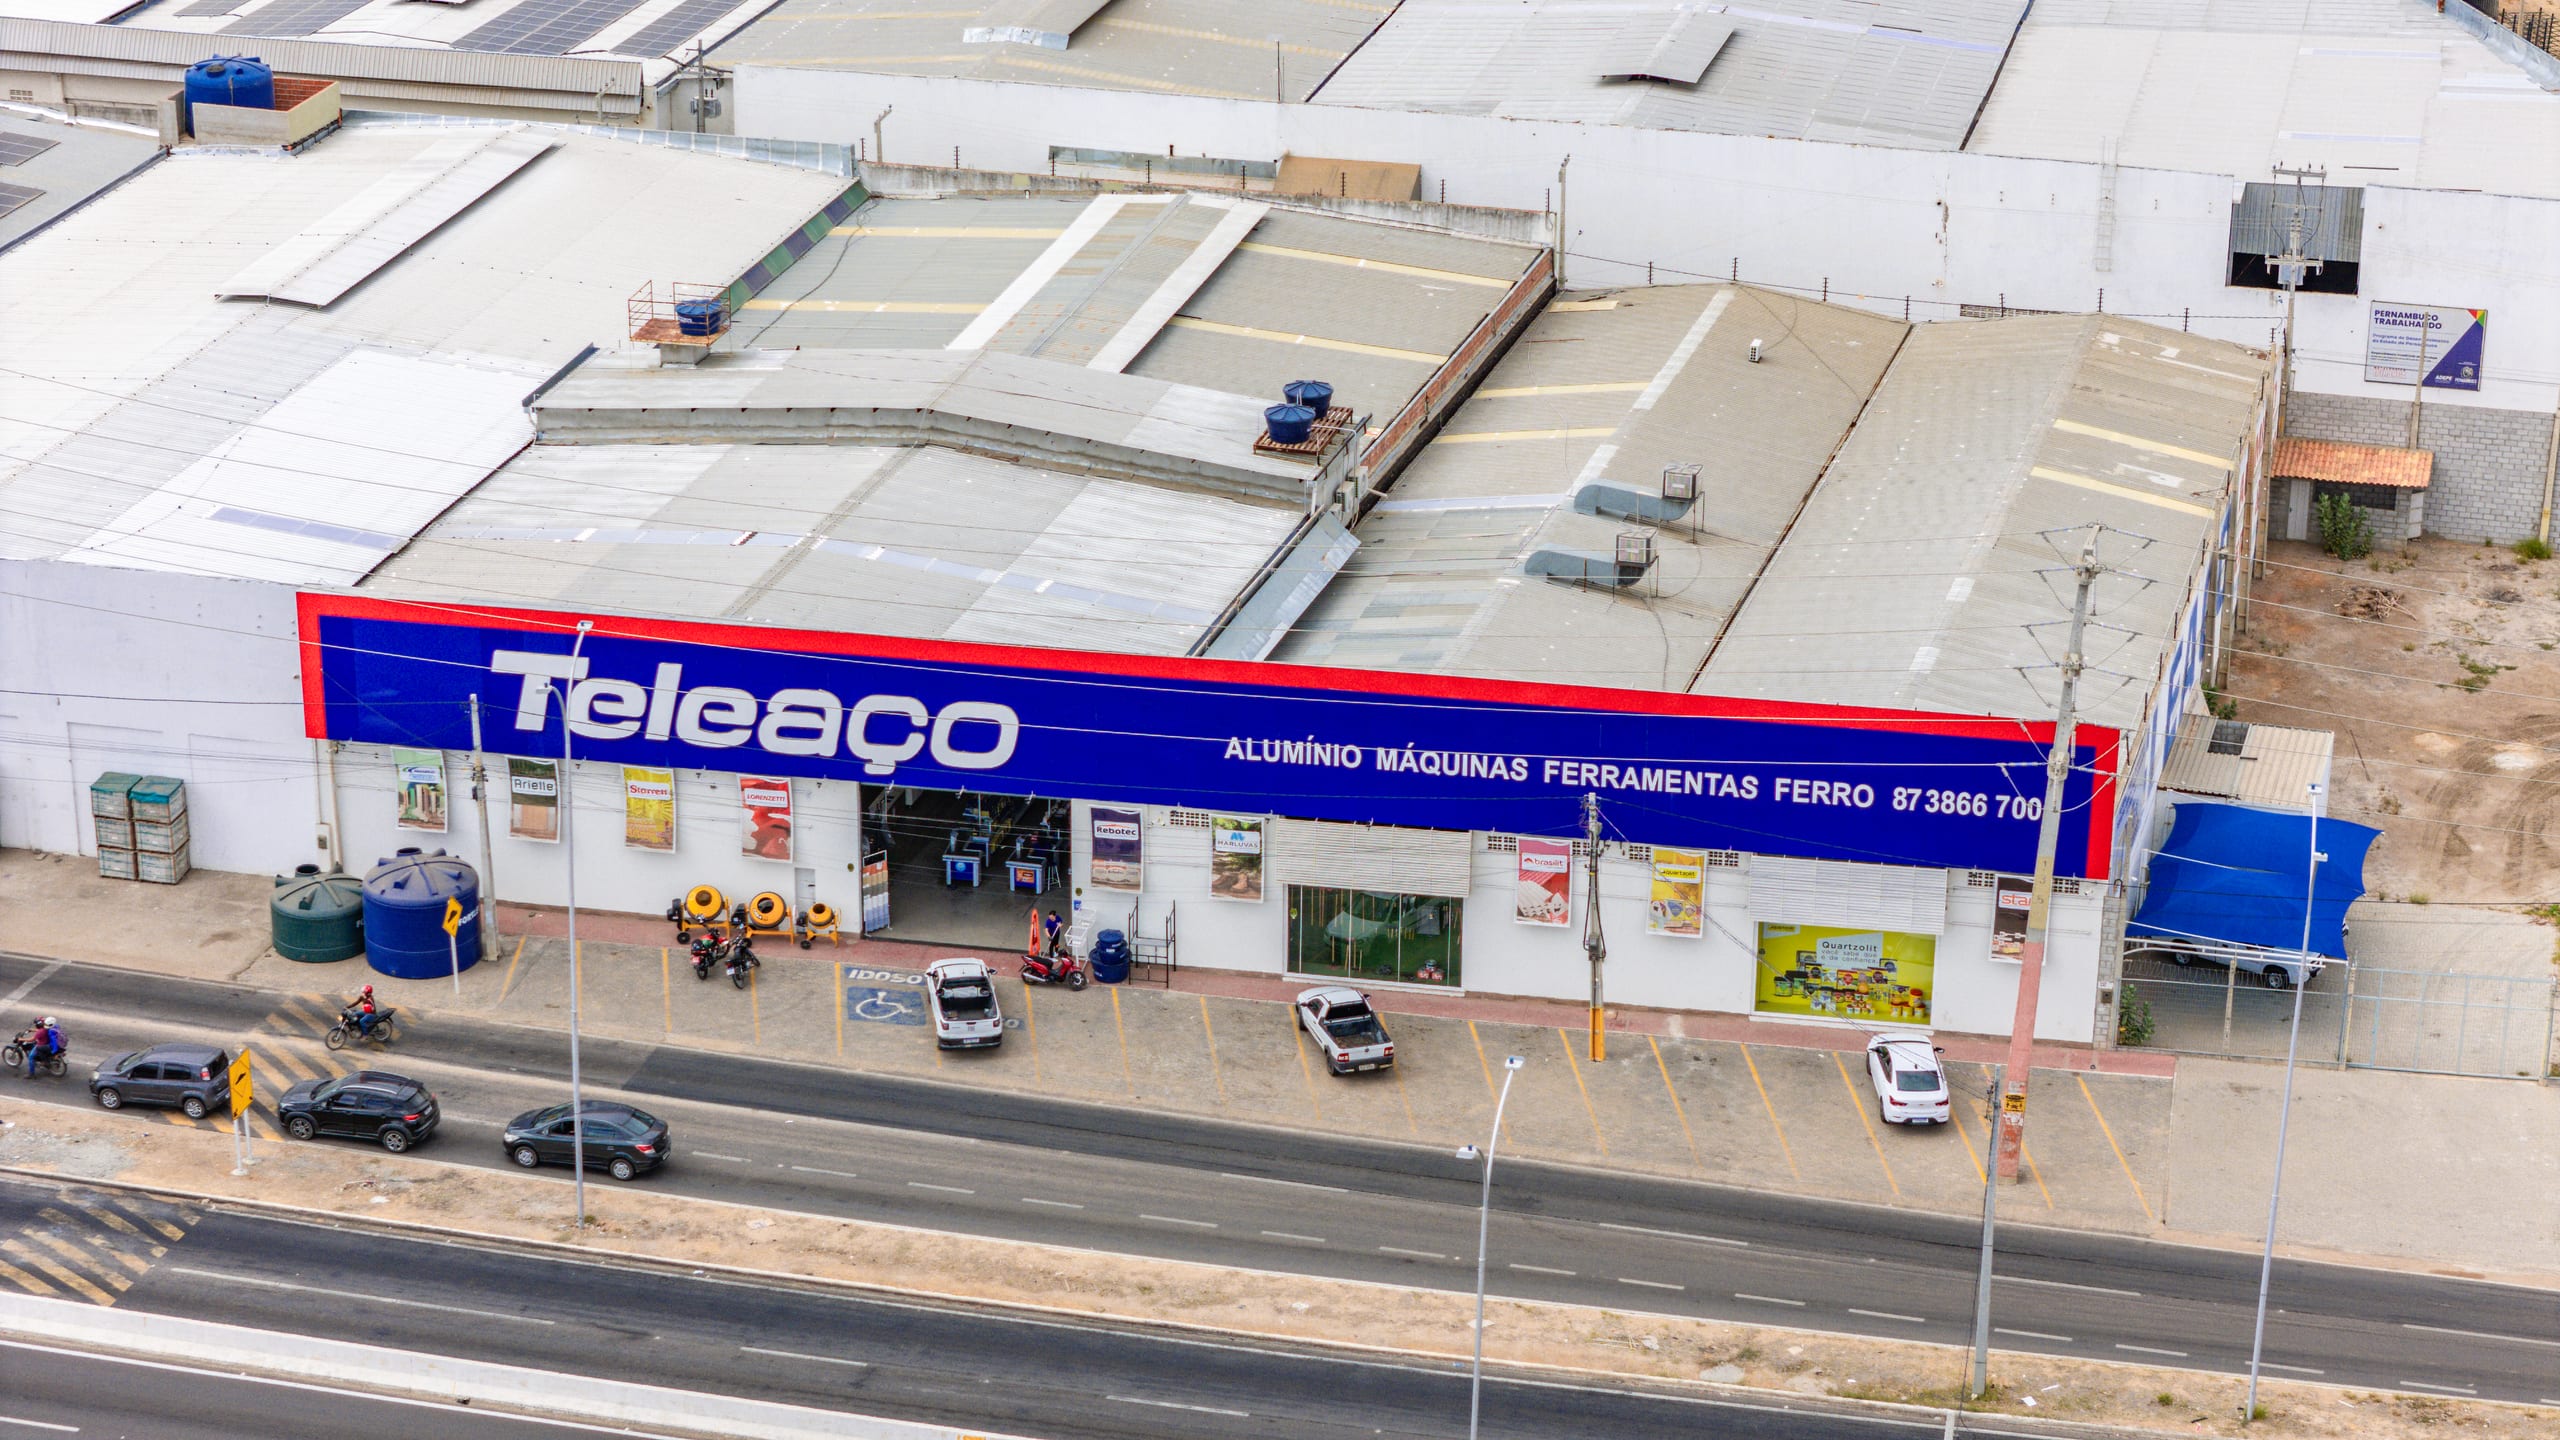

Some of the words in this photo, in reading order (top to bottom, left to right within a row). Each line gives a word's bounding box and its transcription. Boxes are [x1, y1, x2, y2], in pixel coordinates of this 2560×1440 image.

[491, 649, 1020, 776] Teleaço
[1223, 735, 1362, 768] ALUMÍNIO
[1376, 742, 1529, 782] MÁQUINAS
[1543, 759, 1759, 800] FERRAMENTAS
[1775, 777, 1875, 808] FERRO
[1995, 794, 2042, 821] 700
[514, 778, 554, 791] Arielle
[630, 785, 668, 796] Starrett
[747, 794, 785, 802] LORENZETTI
[1096, 826, 1137, 836] Rebotec
[1217, 839, 1258, 849] MARLUVAS
[1534, 857, 1563, 867] brasilit
[1822, 941, 1877, 952] Quartzolit
[848, 969, 923, 985] IDOSO
